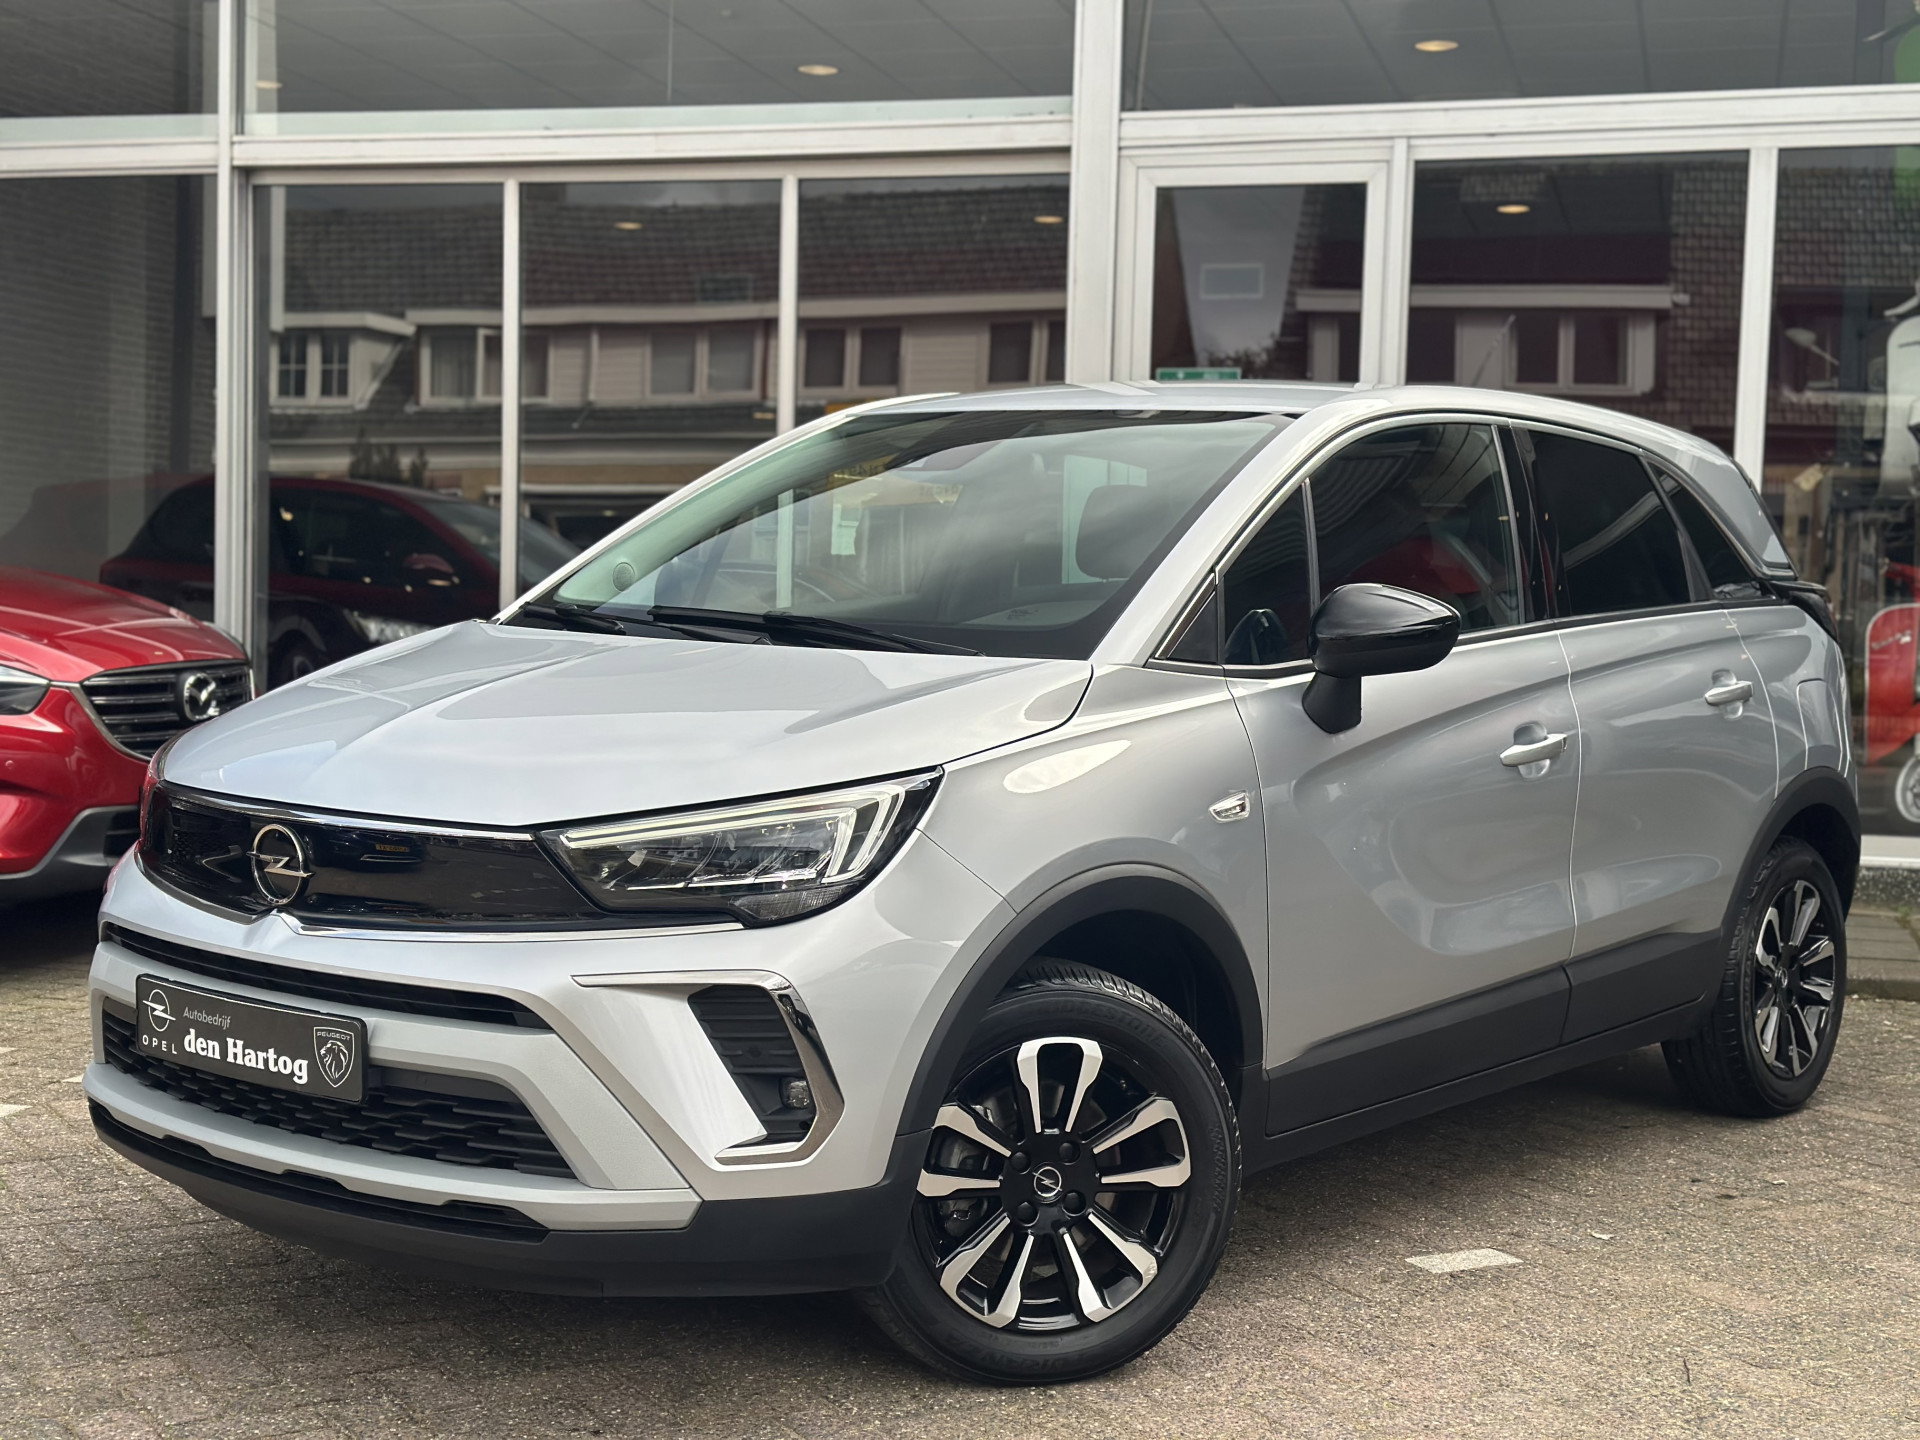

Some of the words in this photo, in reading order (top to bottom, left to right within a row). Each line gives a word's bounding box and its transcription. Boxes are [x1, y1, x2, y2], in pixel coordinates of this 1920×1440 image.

[183, 1006, 231, 1029] Autobedrijf
[142, 1034, 177, 1055] OPEL
[317, 1031, 350, 1041] PEUGEOT
[183, 1028, 221, 1060] den
[226, 1037, 309, 1085] Hartog
